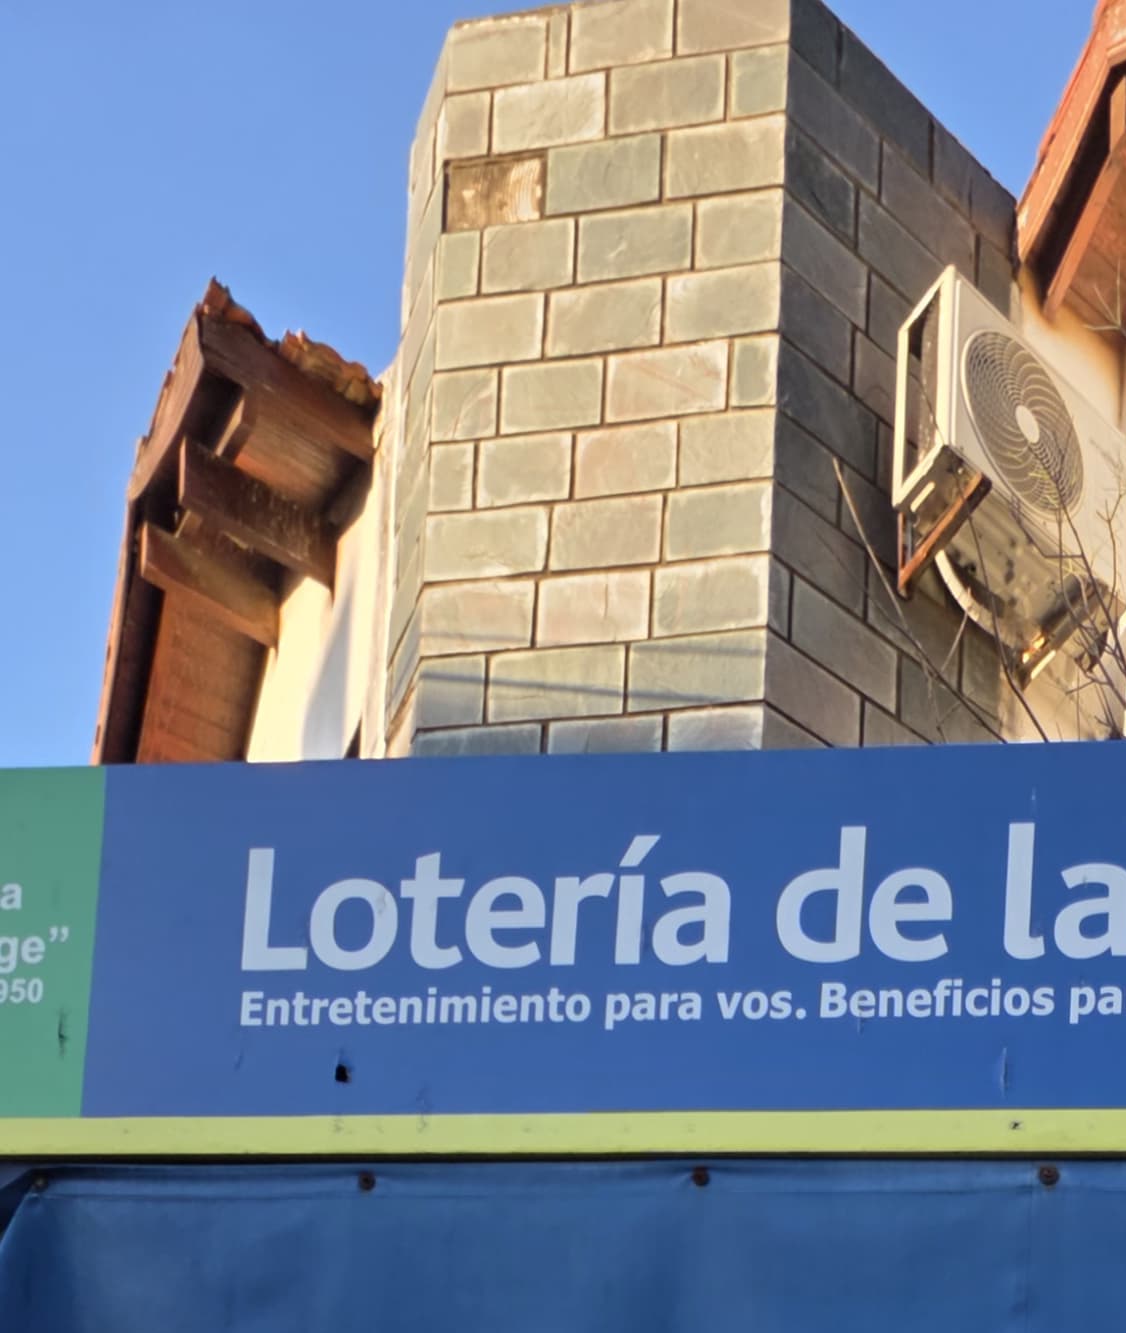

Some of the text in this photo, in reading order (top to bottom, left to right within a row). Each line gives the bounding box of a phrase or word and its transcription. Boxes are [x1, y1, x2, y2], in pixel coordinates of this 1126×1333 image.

[241, 835, 732, 971] Lotería
[775, 825, 953, 964] de
[240, 987, 592, 1027] Entretenimiento
[604, 991, 703, 1030] para
[717, 989, 806, 1020] vos.
[820, 979, 1054, 1019] Beneficios
